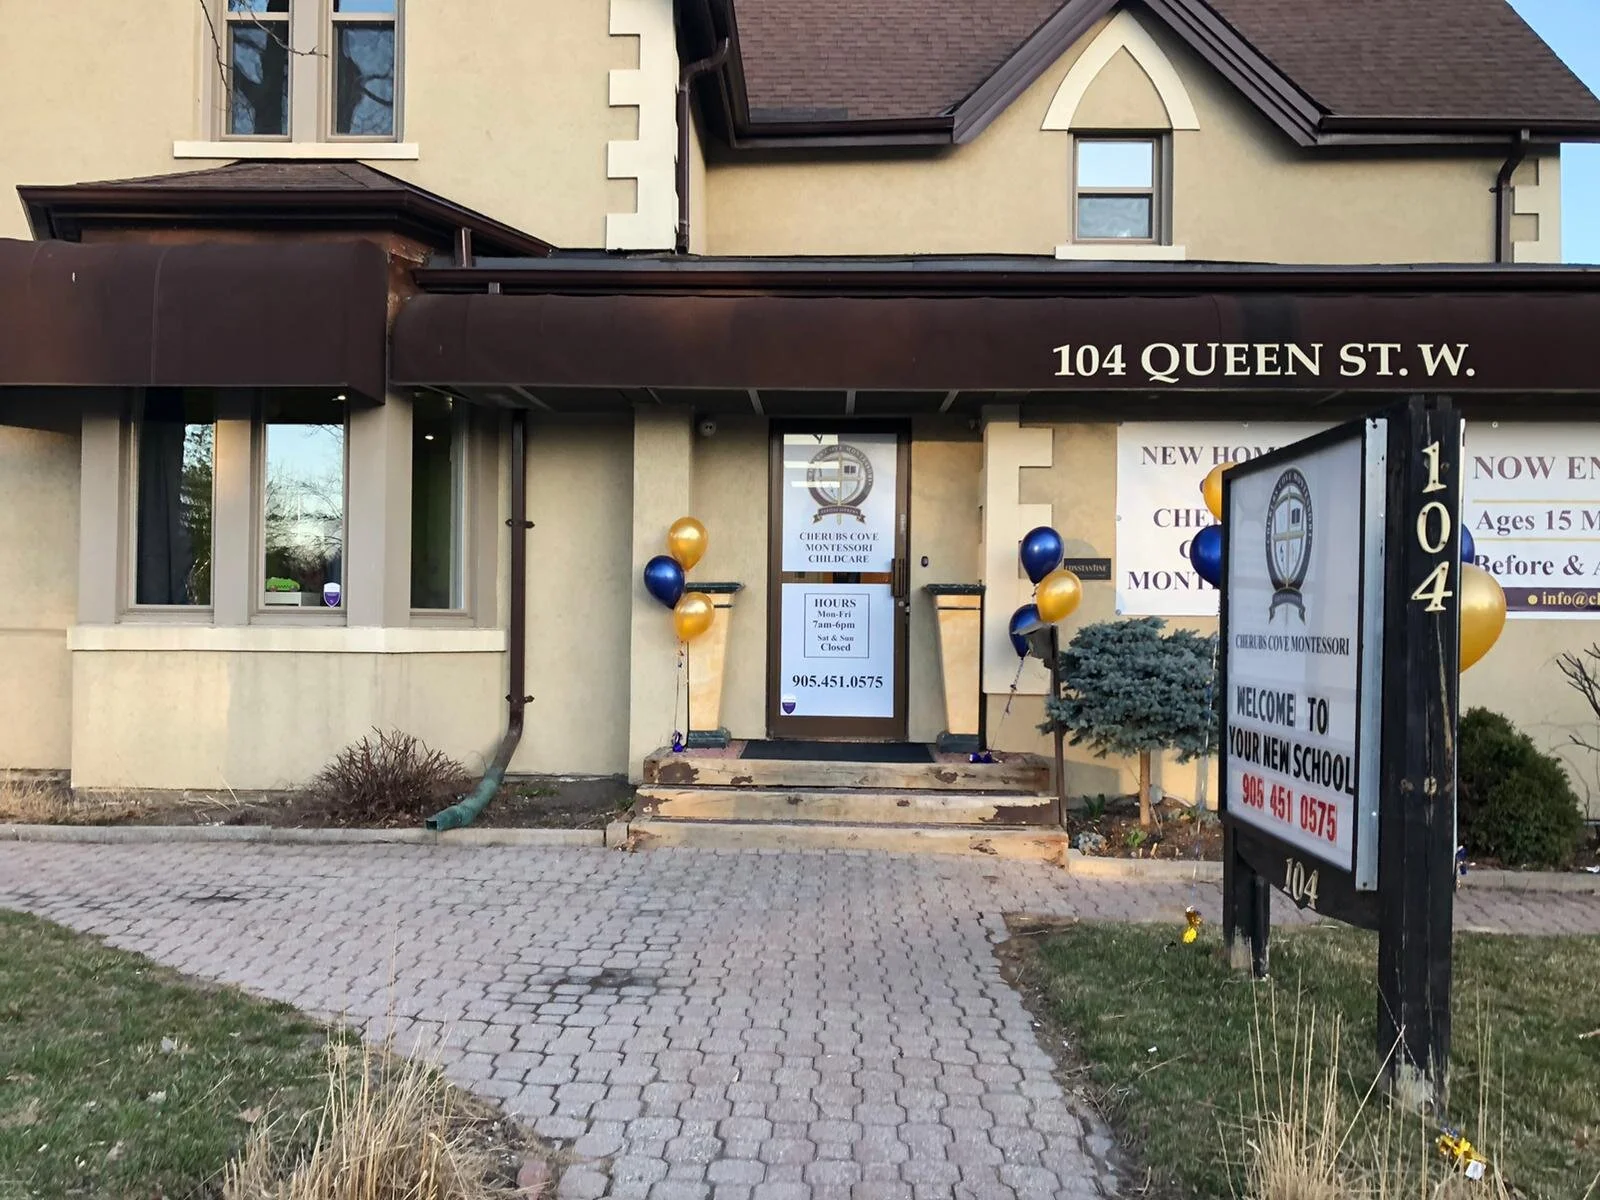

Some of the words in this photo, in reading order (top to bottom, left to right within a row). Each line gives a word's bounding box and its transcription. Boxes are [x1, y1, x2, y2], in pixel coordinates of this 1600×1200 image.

[1053, 344, 1126, 376] 104
[1141, 343, 1323, 384] QUEEN
[1340, 344, 1408, 377] ST.
[1418, 344, 1475, 377] W.
[1142, 446, 1203, 465] NEW
[1474, 456, 1555, 480] NOW
[1153, 508, 1218, 528] CHE
[1411, 441, 1453, 612] 104
[1476, 510, 1535, 536] Ages
[1546, 510, 1572, 531] 15
[800, 532, 848, 541] CHERUBS
[850, 533, 879, 541] COVE
[806, 543, 873, 552] MONTESSORI
[808, 555, 869, 564] CHILDCARE
[1475, 555, 1554, 576] Before
[1562, 555, 1584, 576] &
[1128, 571, 1219, 590] MONT
[814, 599, 857, 608] HOURS
[813, 621, 855, 629] 7am-6pm
[820, 643, 851, 651] Closed
[1235, 634, 1267, 650] CHERUBS
[1268, 636, 1290, 652] COVE
[1291, 636, 1350, 656] MONTESSORI
[792, 675, 883, 689] 905.451.0575
[1237, 686, 1295, 728] WELCOME
[1307, 697, 1329, 735] TO
[1229, 725, 1260, 764] YOUR
[1263, 735, 1290, 776] NEW
[1293, 745, 1355, 796] SCHOOL
[1242, 773, 1264, 810] 905
[1270, 783, 1293, 823] 451
[1300, 794, 1337, 842] 0575
[1282, 857, 1318, 910] 104
